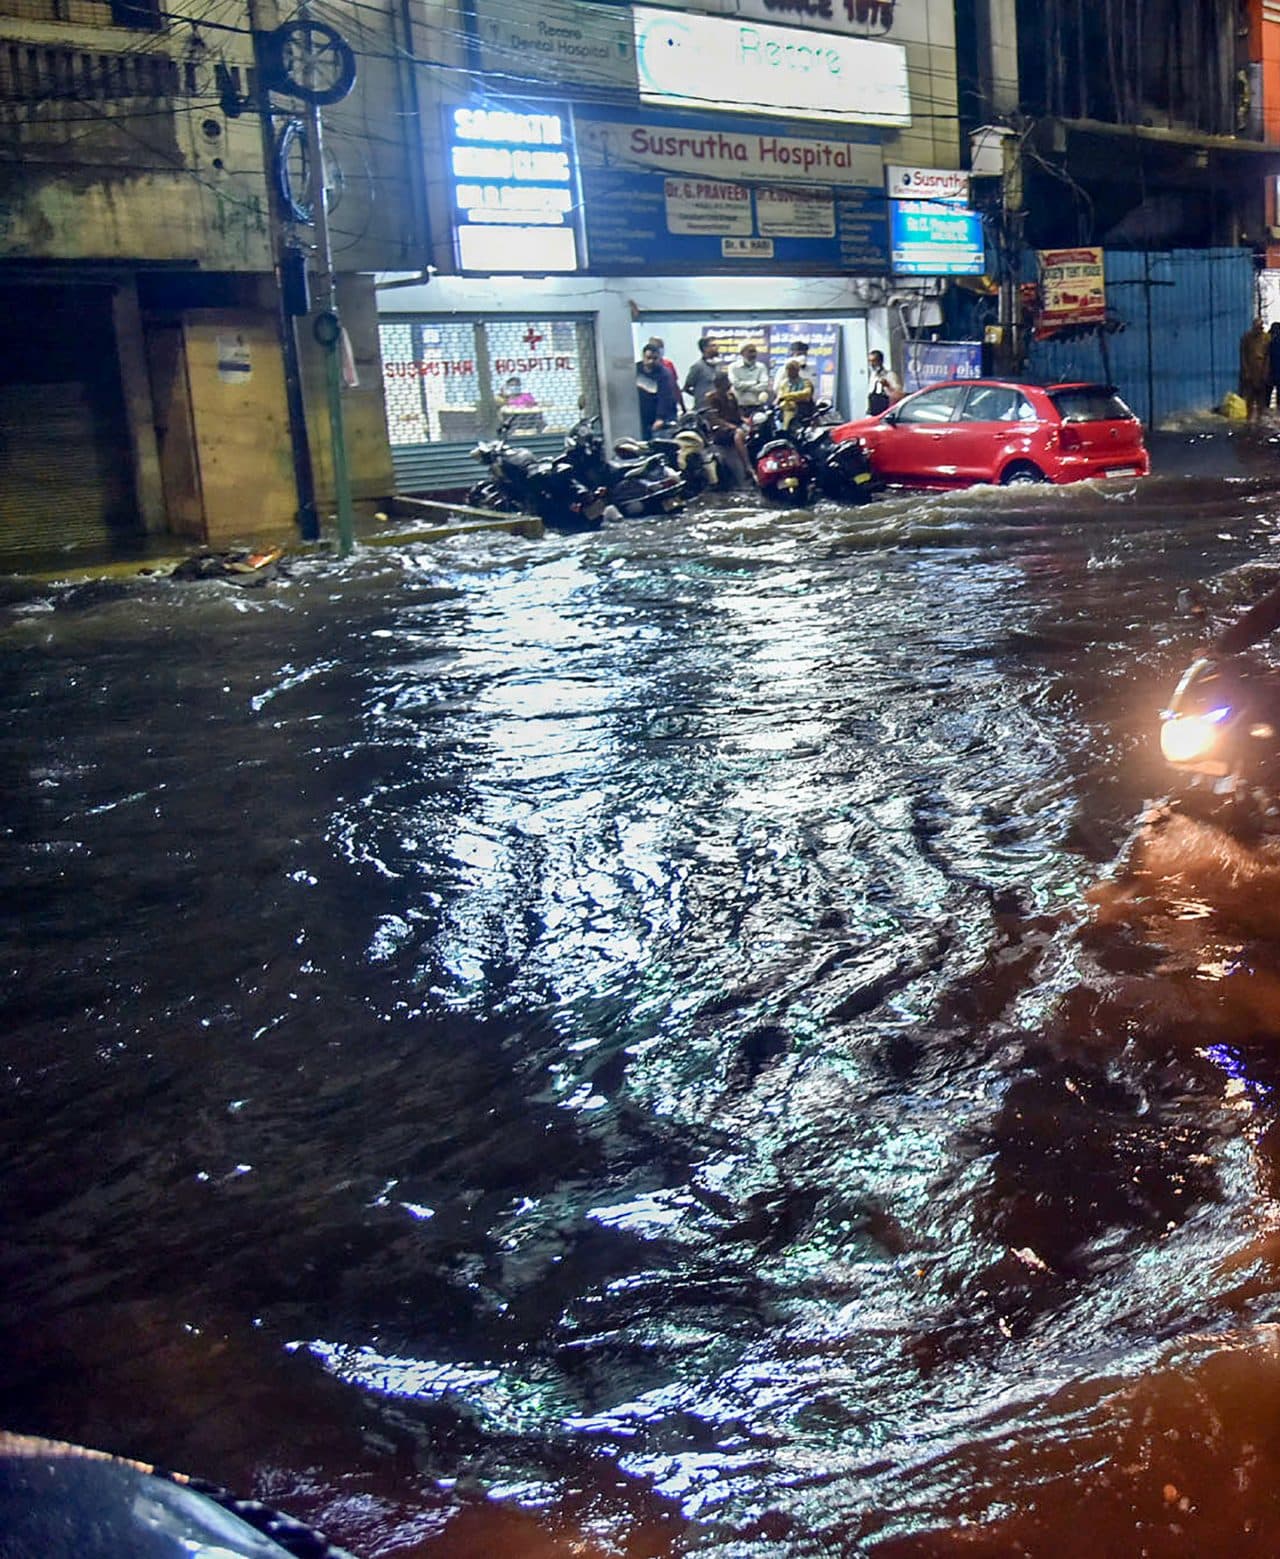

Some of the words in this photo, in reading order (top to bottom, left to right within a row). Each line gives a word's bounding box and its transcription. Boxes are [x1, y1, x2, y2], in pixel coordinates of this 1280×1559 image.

[558, 42, 609, 58] Hospital
[629, 128, 747, 161] Susrutha
[759, 137, 853, 173] Hospital
[385, 360, 474, 379] SUSRUTHA
[495, 357, 575, 375] HOSPITAL
